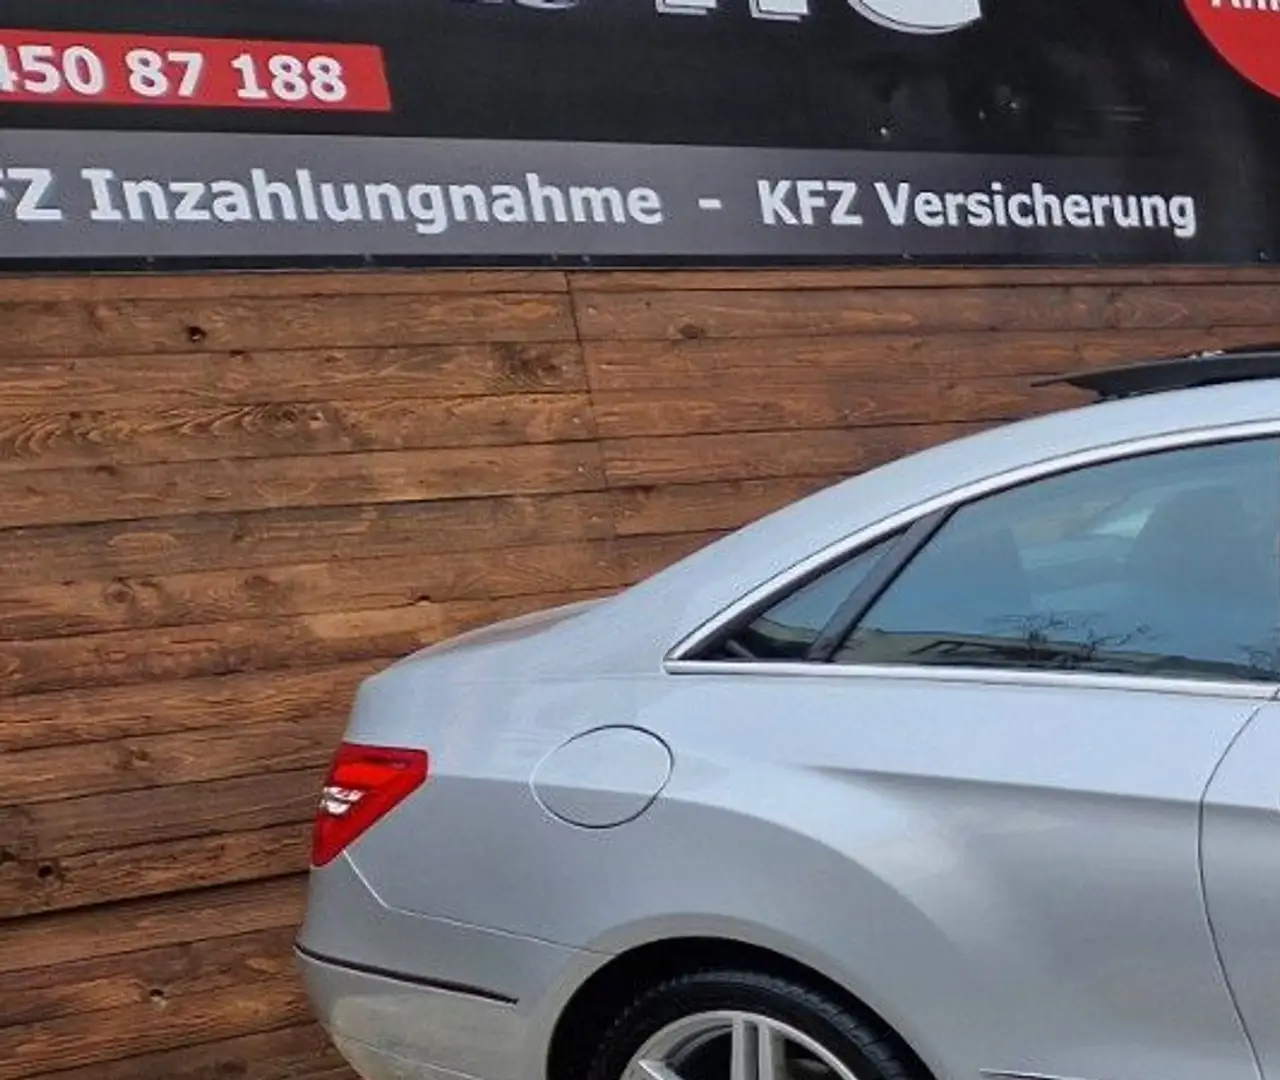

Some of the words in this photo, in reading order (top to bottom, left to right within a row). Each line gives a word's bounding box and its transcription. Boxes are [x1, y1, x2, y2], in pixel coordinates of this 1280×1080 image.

[125, 48, 204, 97] 87
[231, 53, 348, 102] 188
[80, 167, 663, 235] Inzahlungnahme
[698, 197, 722, 211] -
[757, 179, 864, 226] KFZ
[874, 181, 1198, 239] Versicherung
